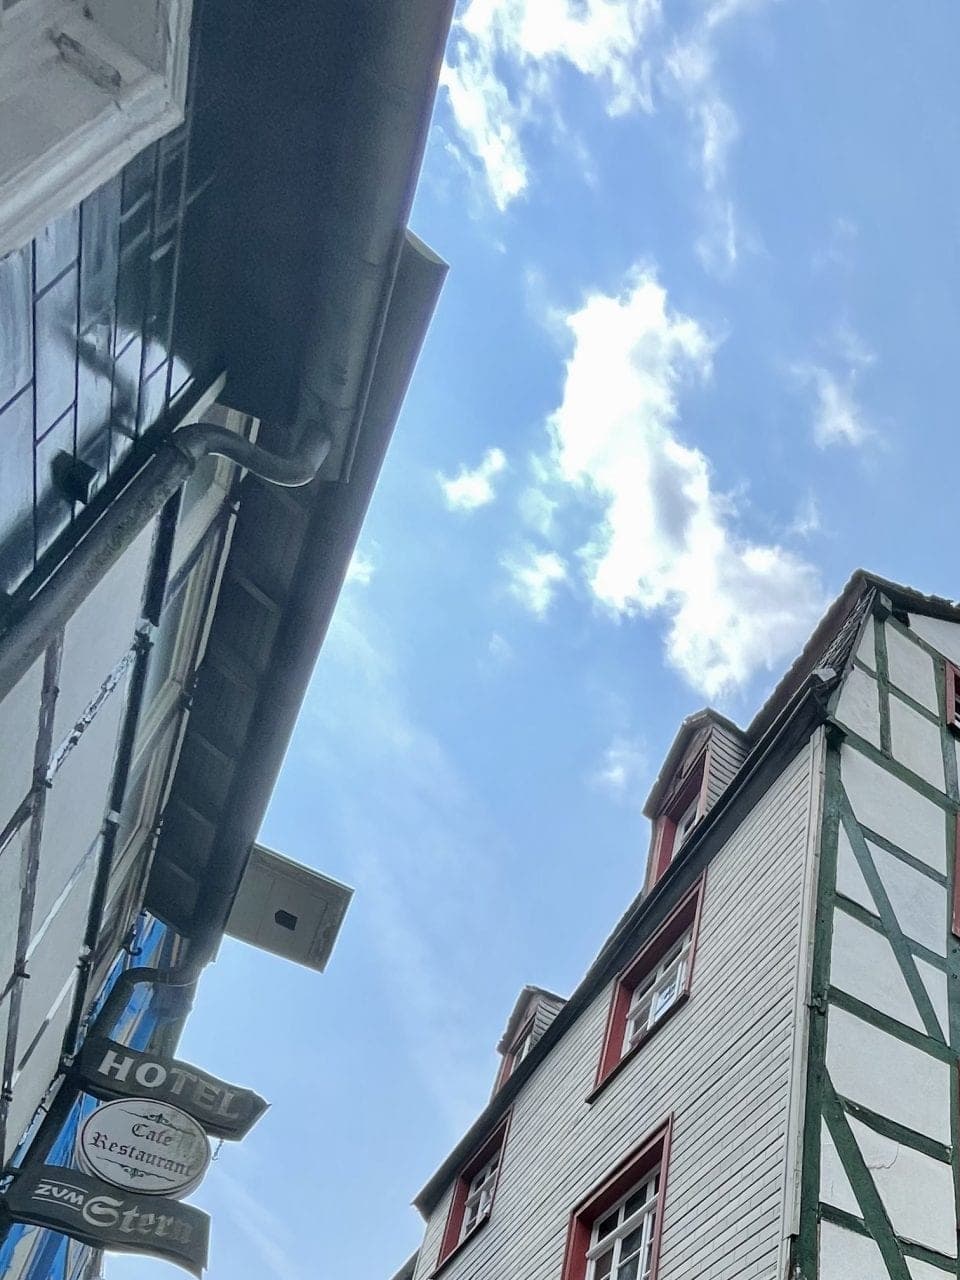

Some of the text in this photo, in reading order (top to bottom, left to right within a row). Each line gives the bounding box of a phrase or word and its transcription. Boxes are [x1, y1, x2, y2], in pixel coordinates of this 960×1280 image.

[98, 1050, 240, 1119] HOTEL
[89, 1131, 195, 1177] Restaurant
[82, 1195, 193, 1243] Stern
